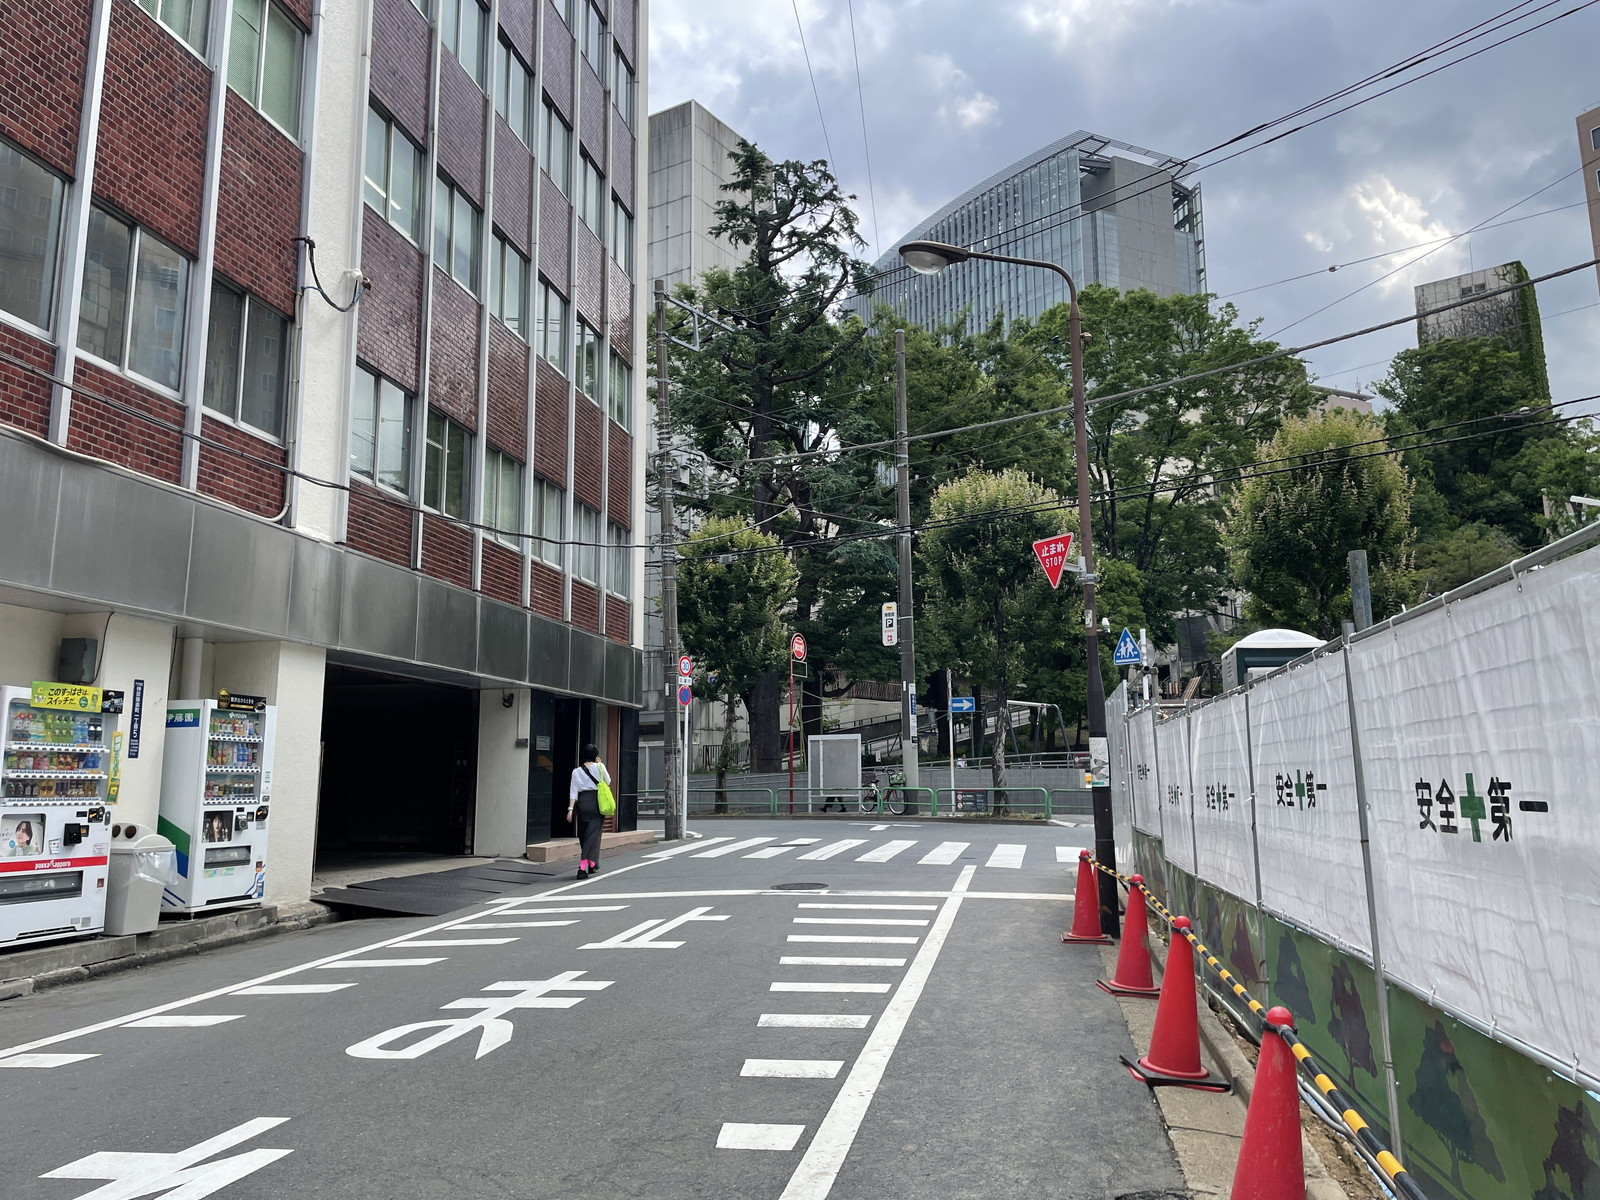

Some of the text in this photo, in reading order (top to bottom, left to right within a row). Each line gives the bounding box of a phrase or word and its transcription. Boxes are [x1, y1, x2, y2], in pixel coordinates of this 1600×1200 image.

[1041, 542, 1066, 557] 止まれ
[1045, 555, 1063, 568] STOP
[682, 661, 690, 671] 30
